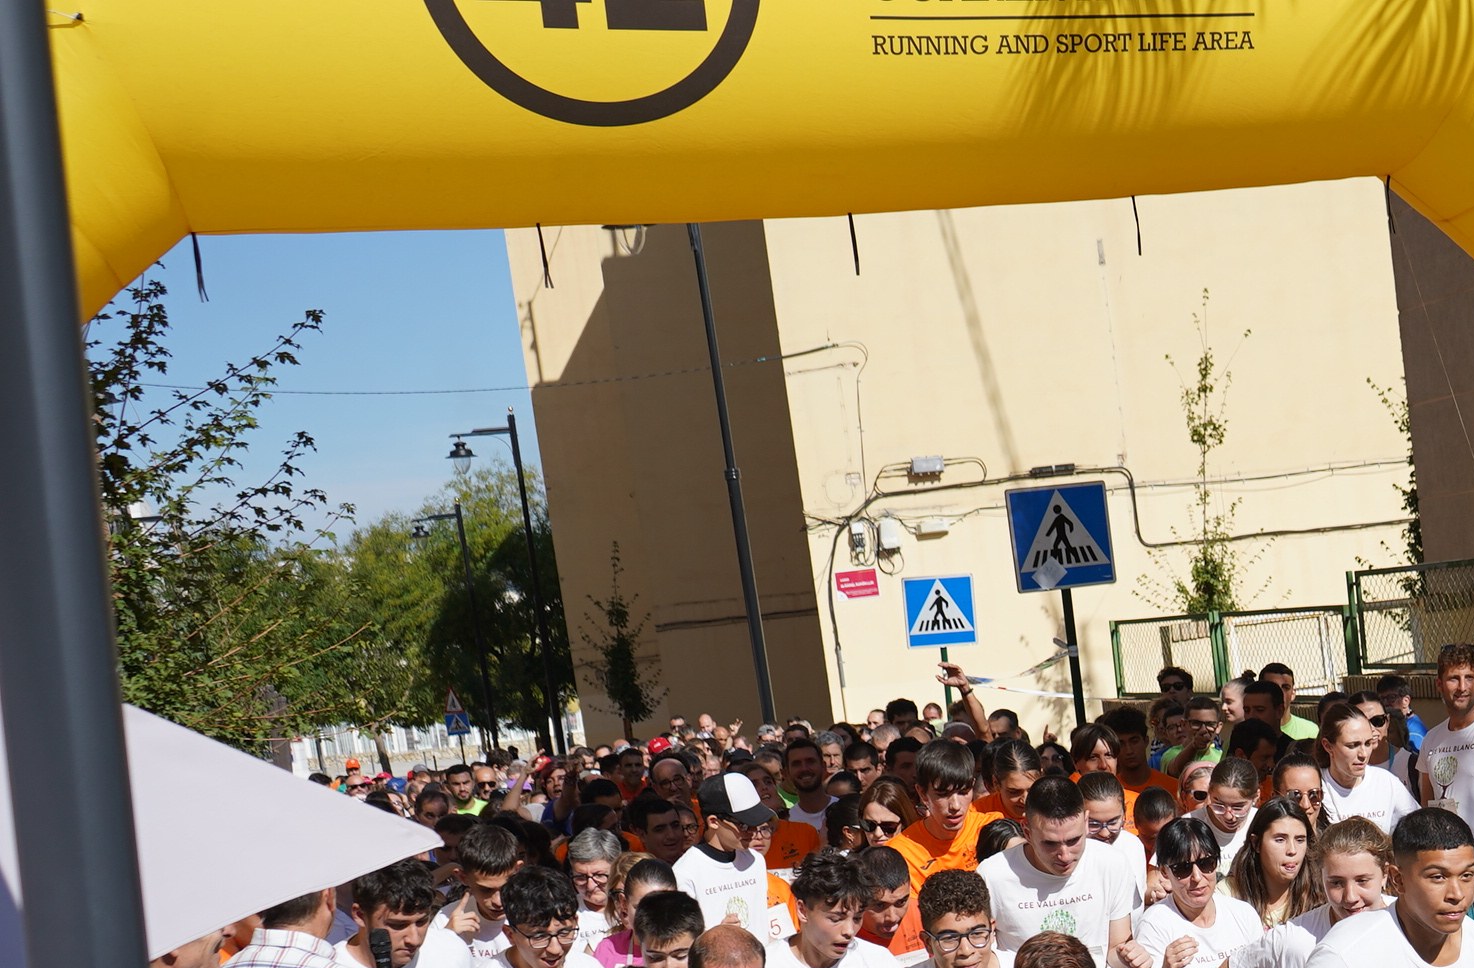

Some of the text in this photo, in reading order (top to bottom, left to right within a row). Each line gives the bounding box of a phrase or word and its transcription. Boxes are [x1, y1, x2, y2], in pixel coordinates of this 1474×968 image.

[872, 31, 1255, 55] RUNNING AND SPORT LIFE AREA
[705, 887, 718, 896] CEE
[719, 883, 734, 892] VALL
[1018, 893, 1093, 910] CEE VALL BLANCA
